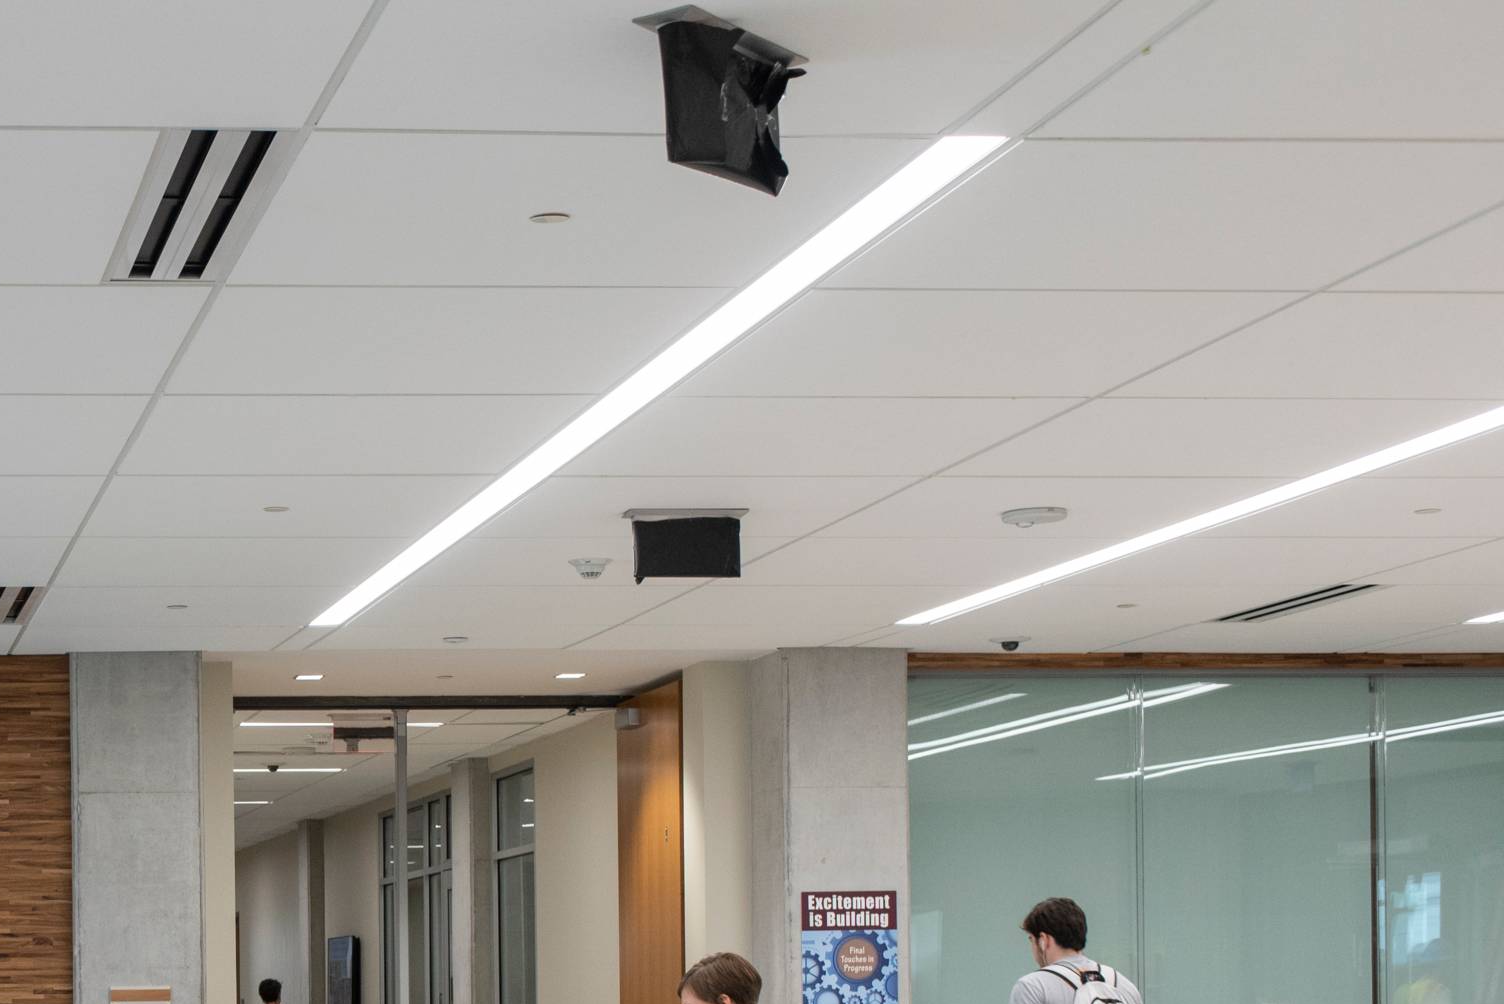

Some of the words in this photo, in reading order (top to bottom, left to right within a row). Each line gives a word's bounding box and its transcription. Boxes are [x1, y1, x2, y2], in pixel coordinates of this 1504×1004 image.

[808, 895, 890, 910] Excitement
[809, 911, 823, 927] is
[826, 911, 889, 928] Building
[849, 946, 865, 954] Final
[843, 963, 873, 974] Progress
